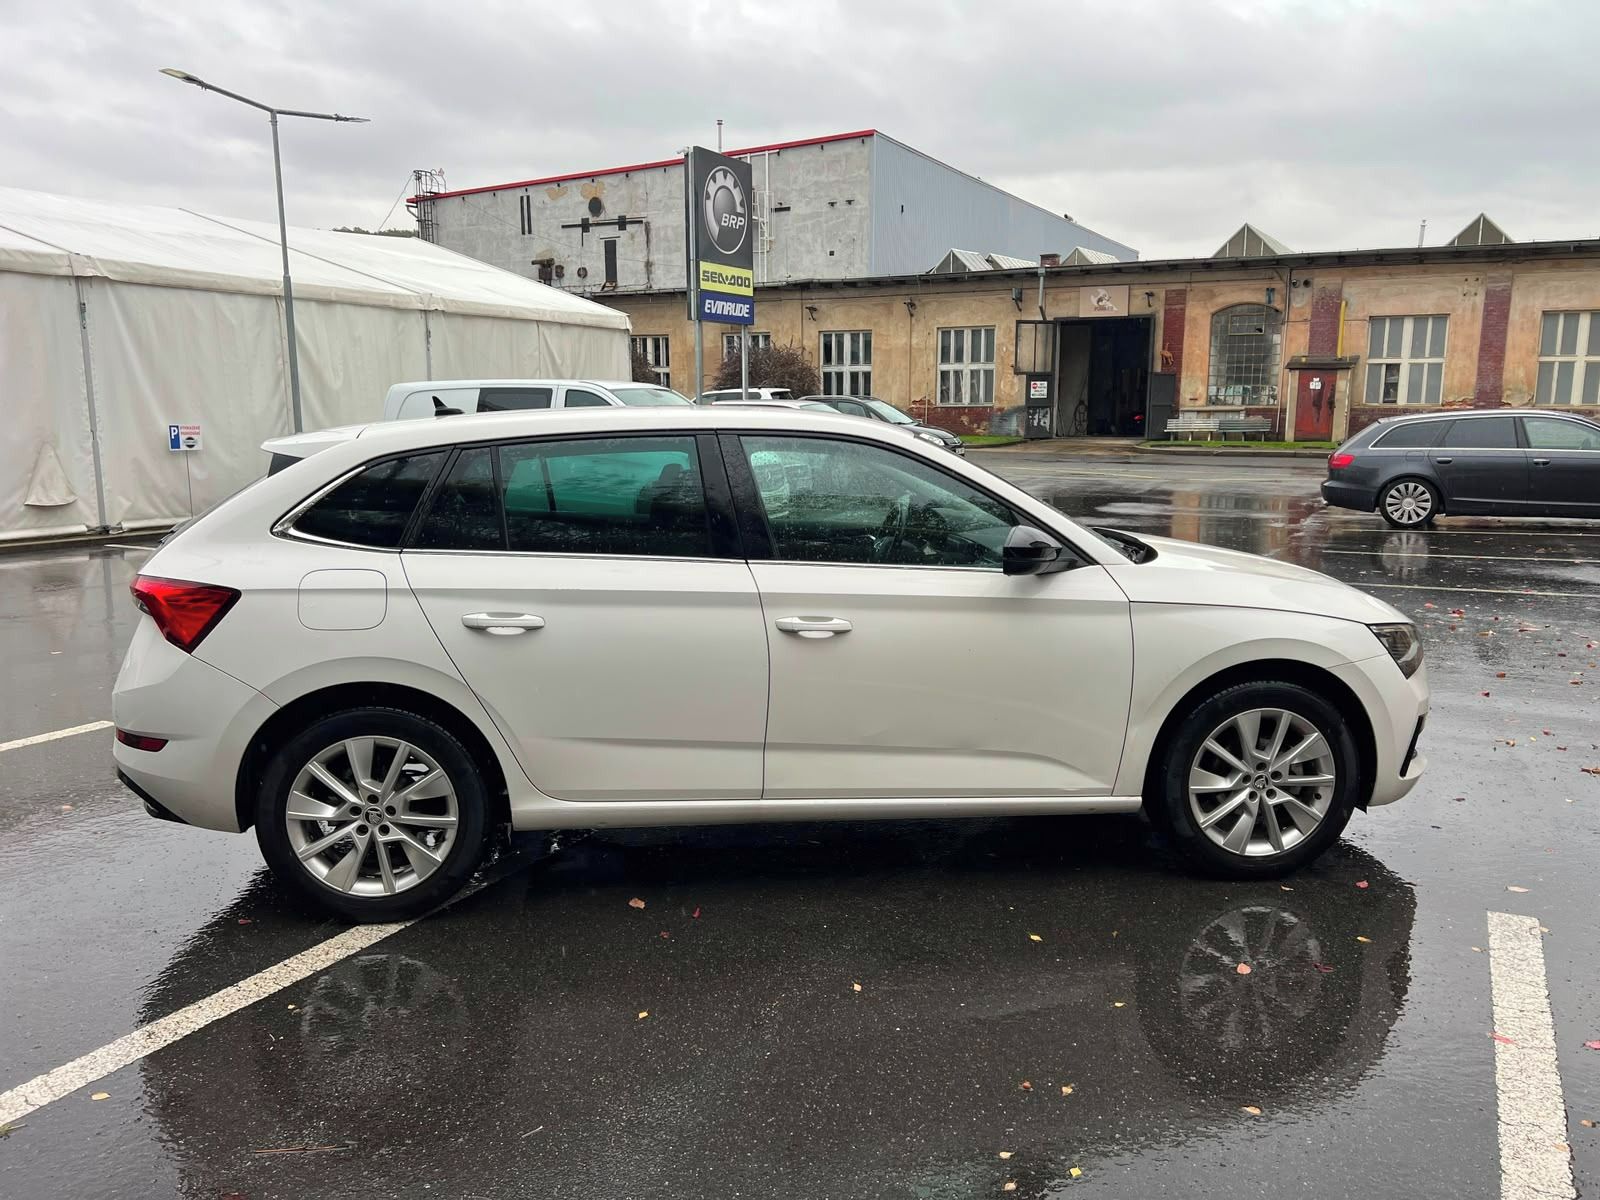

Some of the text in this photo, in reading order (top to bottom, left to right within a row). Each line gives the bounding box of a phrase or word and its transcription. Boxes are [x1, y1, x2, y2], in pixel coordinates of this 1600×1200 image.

[721, 213, 745, 230] BRP
[704, 299, 750, 317] EVINRUDE
[170, 427, 178, 439] P
